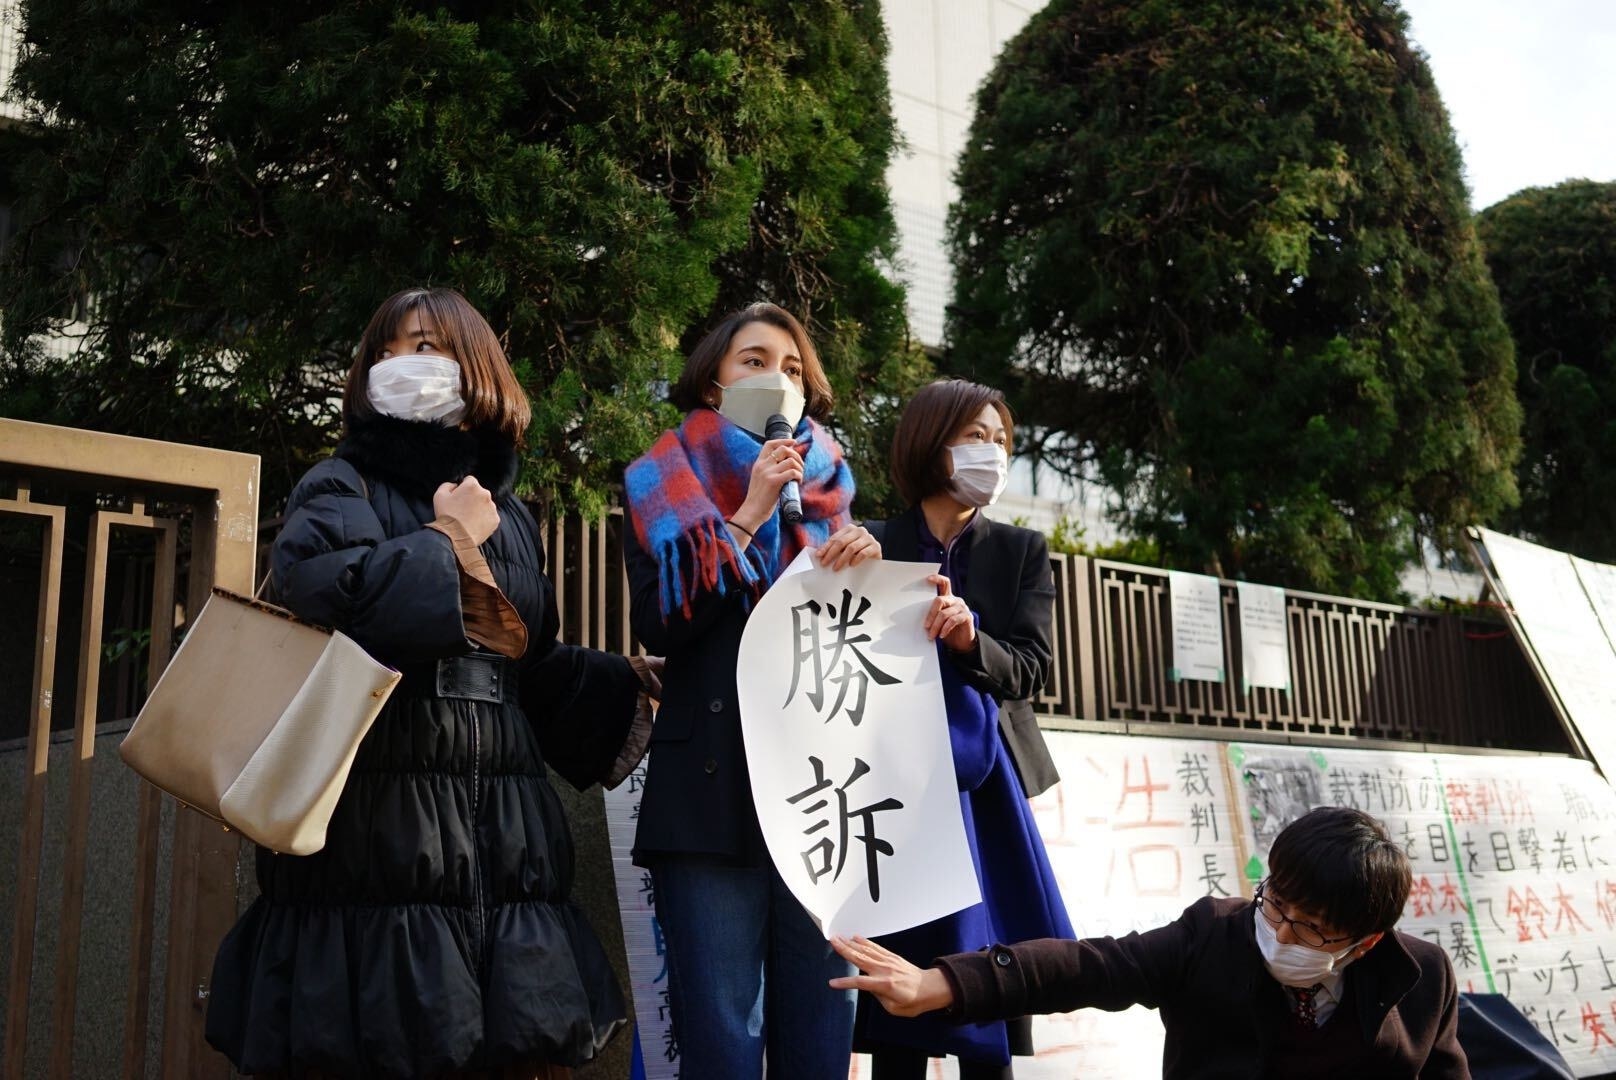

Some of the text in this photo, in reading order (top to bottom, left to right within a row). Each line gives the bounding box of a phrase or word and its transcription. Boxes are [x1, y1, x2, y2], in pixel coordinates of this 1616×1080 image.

[782, 588, 904, 903] 勝訴
[1328, 767, 1441, 812] 裁判所の
[1177, 752, 1231, 897] 裁判長
[1461, 826, 1609, 879] を目撃者に
